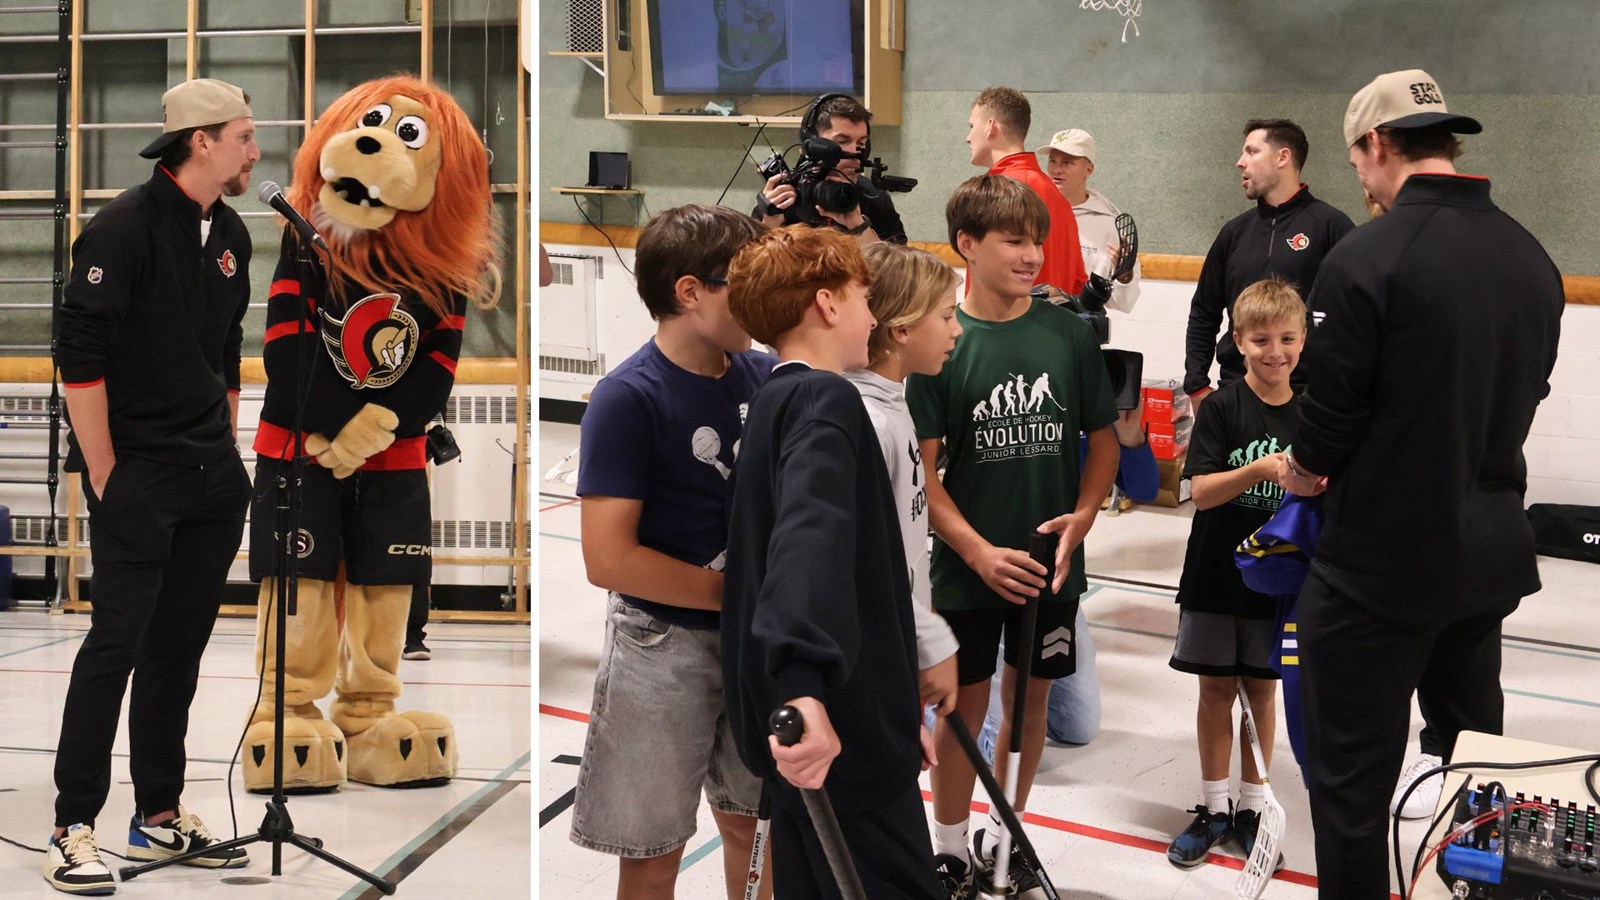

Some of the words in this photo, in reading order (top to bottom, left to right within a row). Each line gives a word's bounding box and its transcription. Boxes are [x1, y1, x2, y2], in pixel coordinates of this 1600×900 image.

[988, 418, 1011, 429] ÉCOLE
[1013, 416, 1023, 425] DE
[975, 422, 1063, 449] ÉVOLUTION
[981, 448, 1016, 460] JUNIOR
[1020, 445, 1060, 455] LESSARD
[387, 544, 431, 556] CCM
